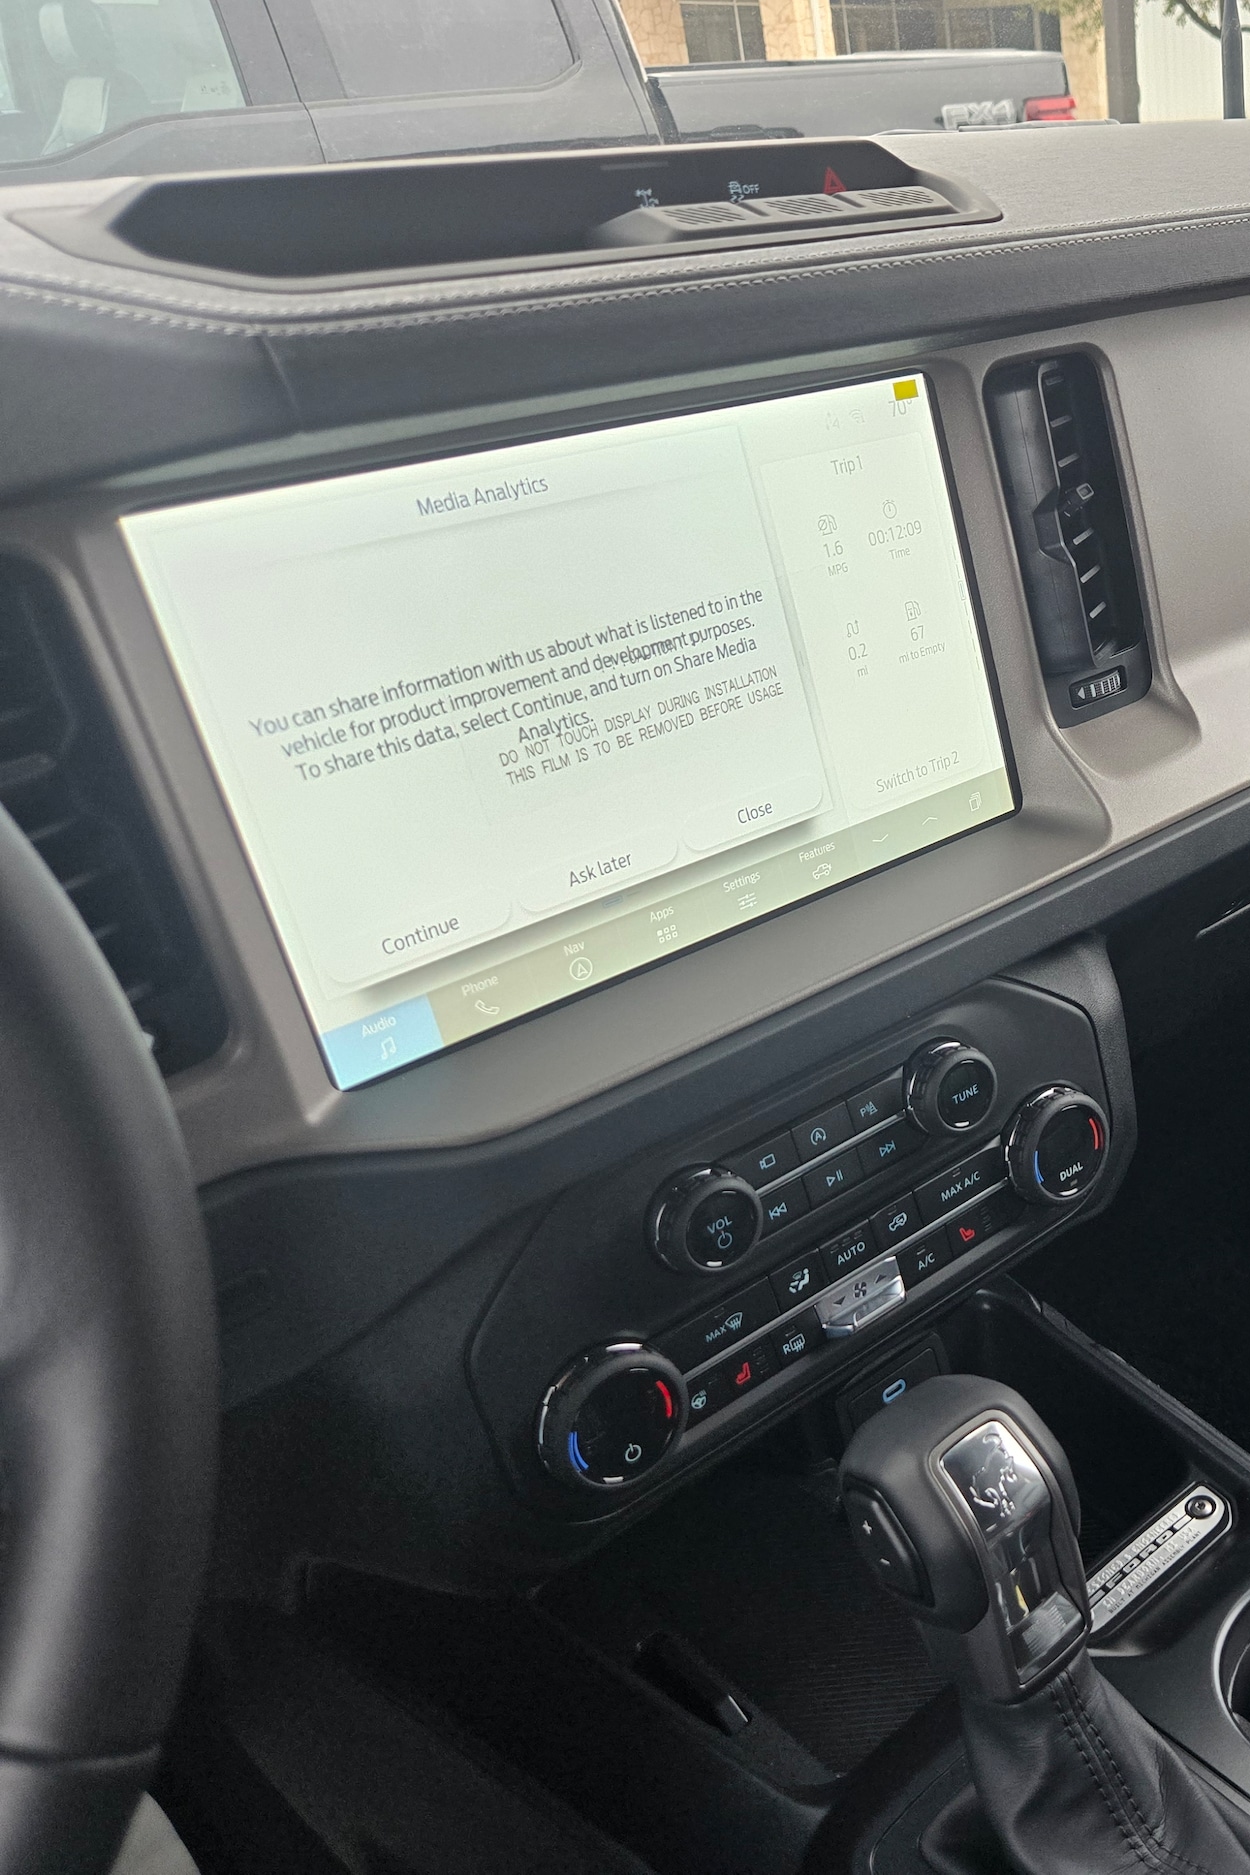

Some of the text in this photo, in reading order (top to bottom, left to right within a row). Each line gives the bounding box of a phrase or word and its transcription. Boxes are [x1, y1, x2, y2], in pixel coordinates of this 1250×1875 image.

[941, 99, 1015, 130] FX4
[742, 184, 759, 194] OFF
[830, 455, 864, 476] Trip 1
[416, 477, 549, 516] Media Analytics
[867, 520, 922, 547] 00:12:09
[823, 540, 844, 558] 1.6
[889, 546, 911, 560] Time
[827, 562, 849, 576] MPG
[910, 625, 925, 641] 67
[848, 643, 868, 661] 0.2
[910, 649, 920, 661] to
[920, 641, 946, 658] Empty
[249, 588, 764, 737] You can share information with us about what is listened to in the
[857, 664, 869, 677] mi
[280, 615, 755, 758] vehicle for product improvement and development purposes.
[295, 637, 757, 781] To share this data, select Continue, and turn on Share Media
[499, 665, 778, 767] DO NOT TOUCH DISPLAY DURING INSTALLATION
[506, 682, 784, 785] THIS FILM IS TO BE REMOVED BEFORE USAGE
[518, 710, 594, 743] Analytics.
[876, 751, 960, 793] Switch to Trip 2
[737, 802, 773, 824] Close
[799, 842, 835, 863] Features
[569, 852, 633, 887] Ask later
[723, 871, 761, 893] Settings
[650, 905, 674, 923] Apps
[381, 916, 460, 955] Continue
[563, 940, 585, 957] Nav
[461, 974, 499, 997] Phone
[361, 1015, 396, 1037] Audio
[952, 1083, 979, 1105] TUNE
[1059, 1162, 1084, 1182] DUAL
[940, 1171, 981, 1202] MAX A/C
[707, 1215, 733, 1234] VOL
[837, 1241, 866, 1265] AUTO
[917, 1253, 936, 1271] A/C
[706, 1325, 727, 1343] MAX
[1106, 1529, 1174, 1589] FORD
[1135, 1567, 1161, 1589] MICHIGAN
[1187, 1530, 1202, 1545] PLANT
[1088, 1557, 1124, 1594] ESIGNED
